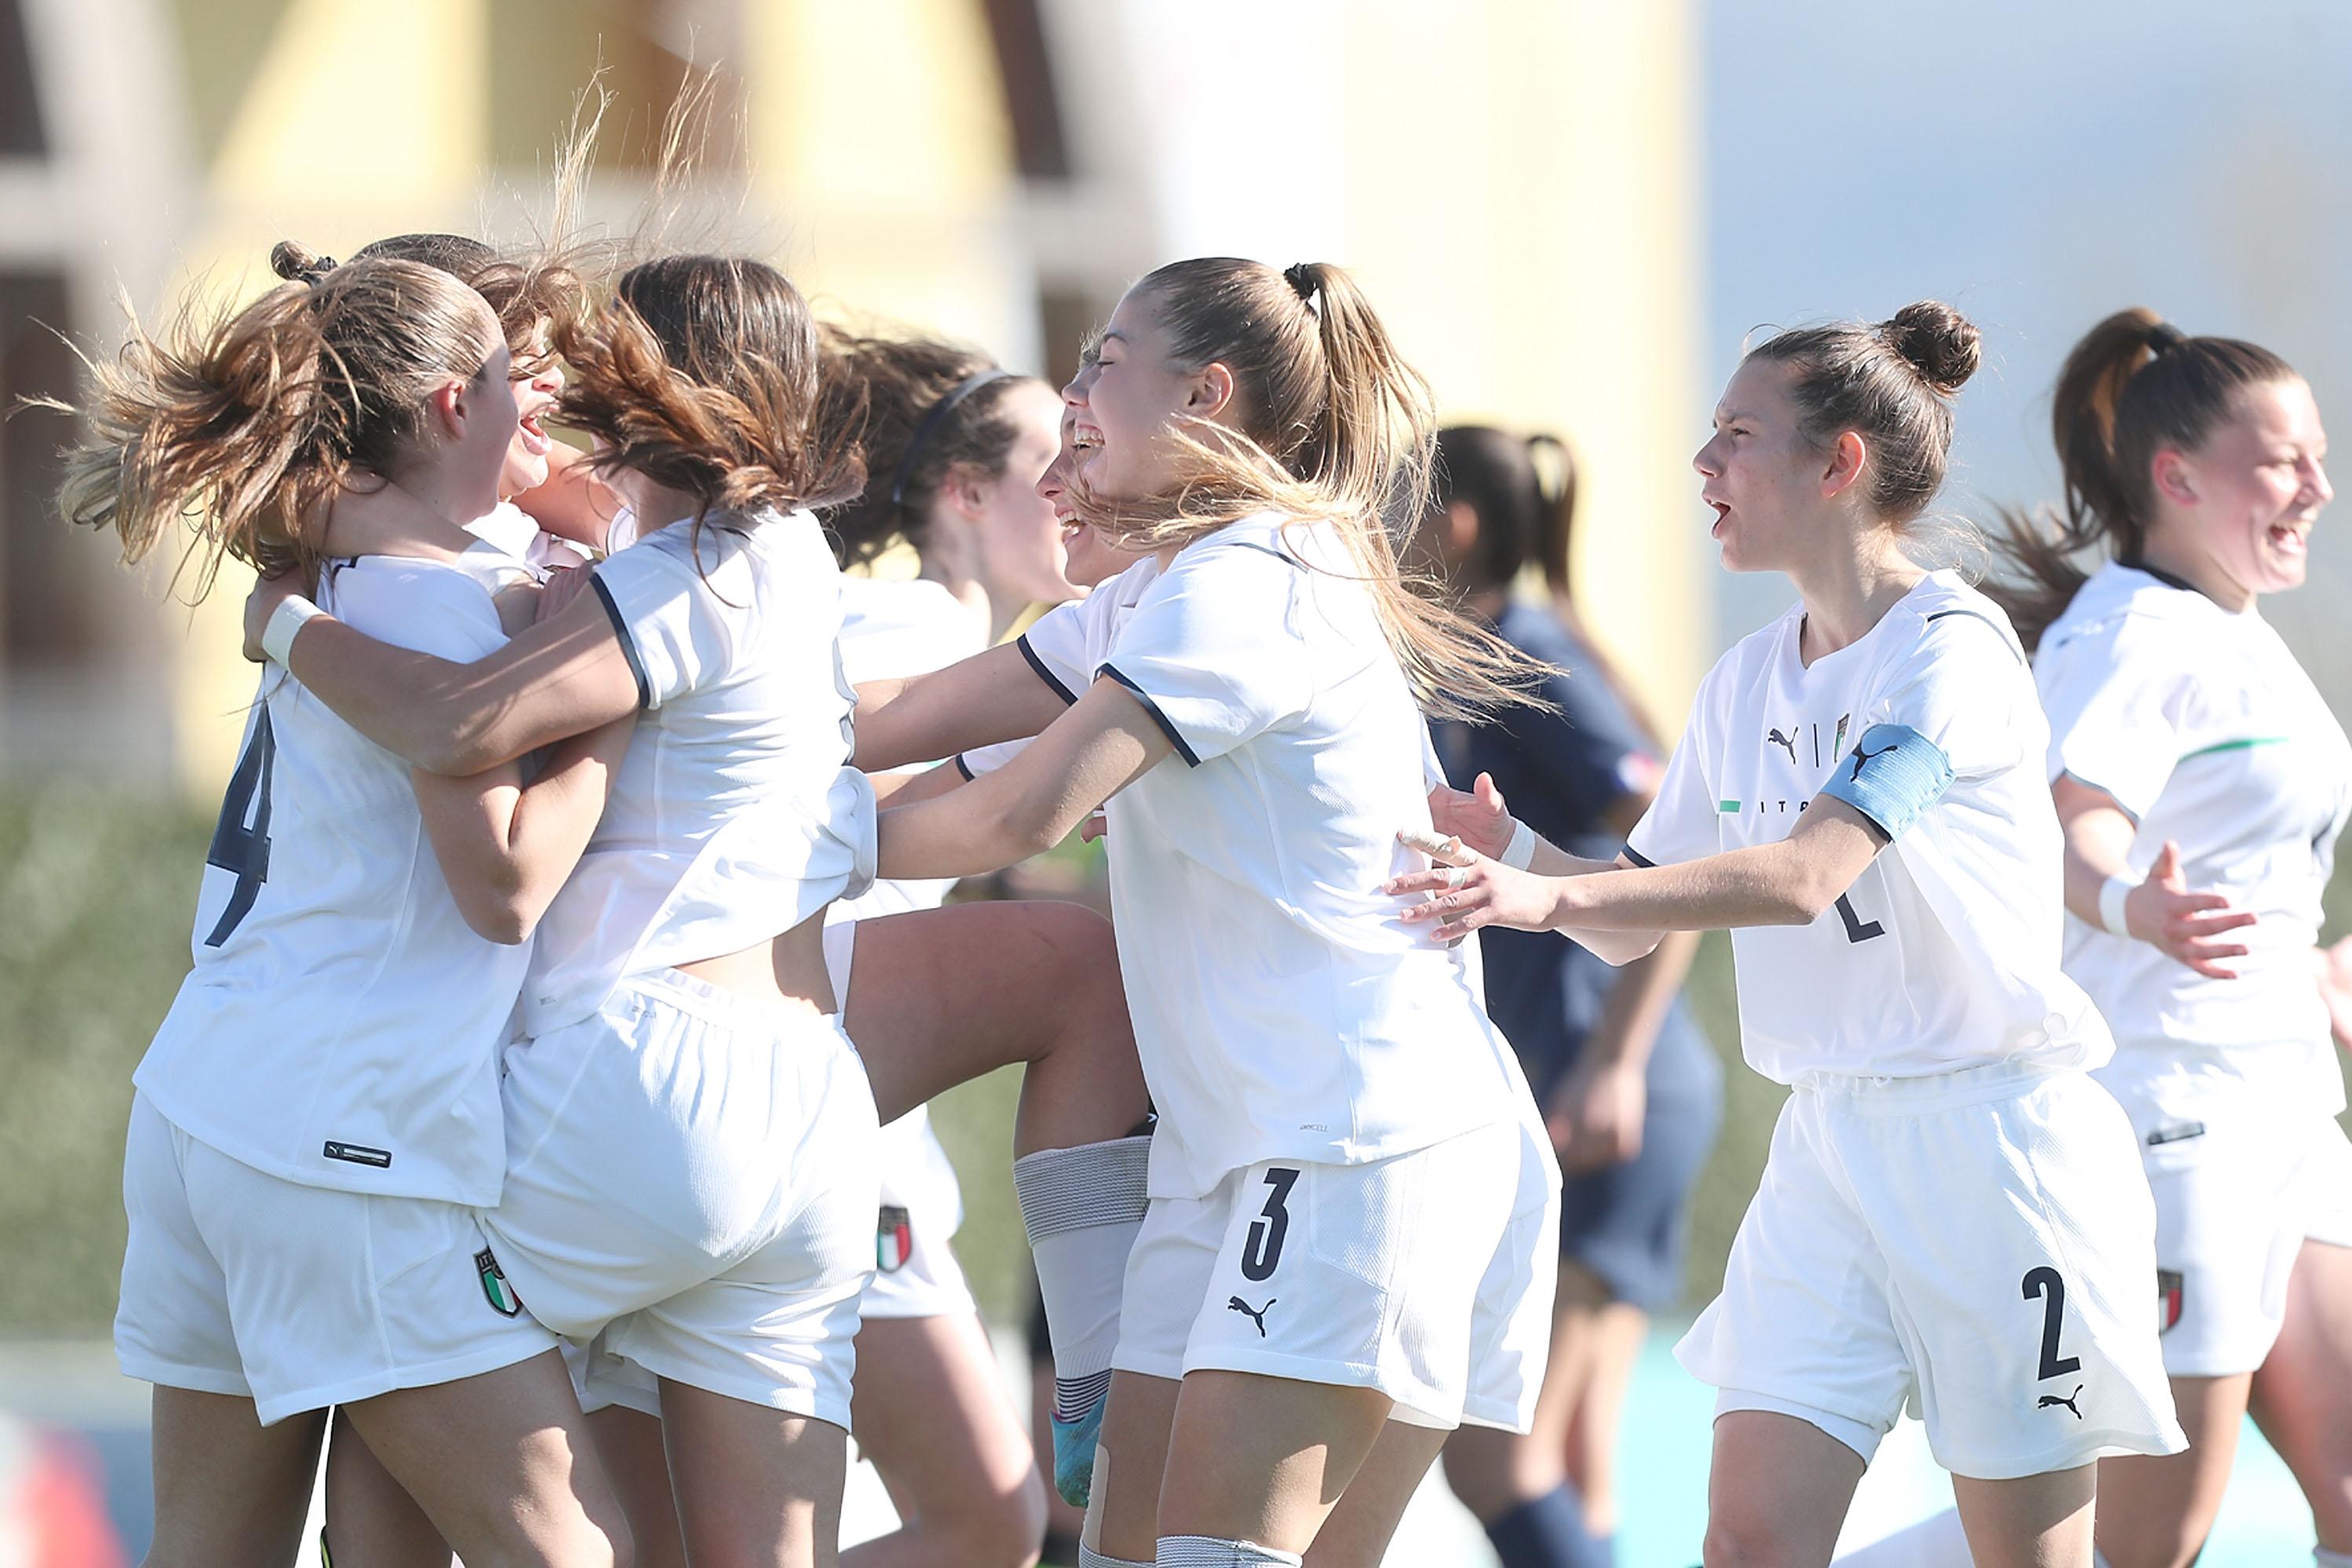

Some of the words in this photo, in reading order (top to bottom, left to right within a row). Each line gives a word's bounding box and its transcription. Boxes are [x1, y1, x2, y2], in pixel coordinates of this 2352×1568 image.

[203, 696, 277, 948] 4
[1241, 1166, 1301, 1282] 3
[2022, 1266, 2081, 1381] 2
